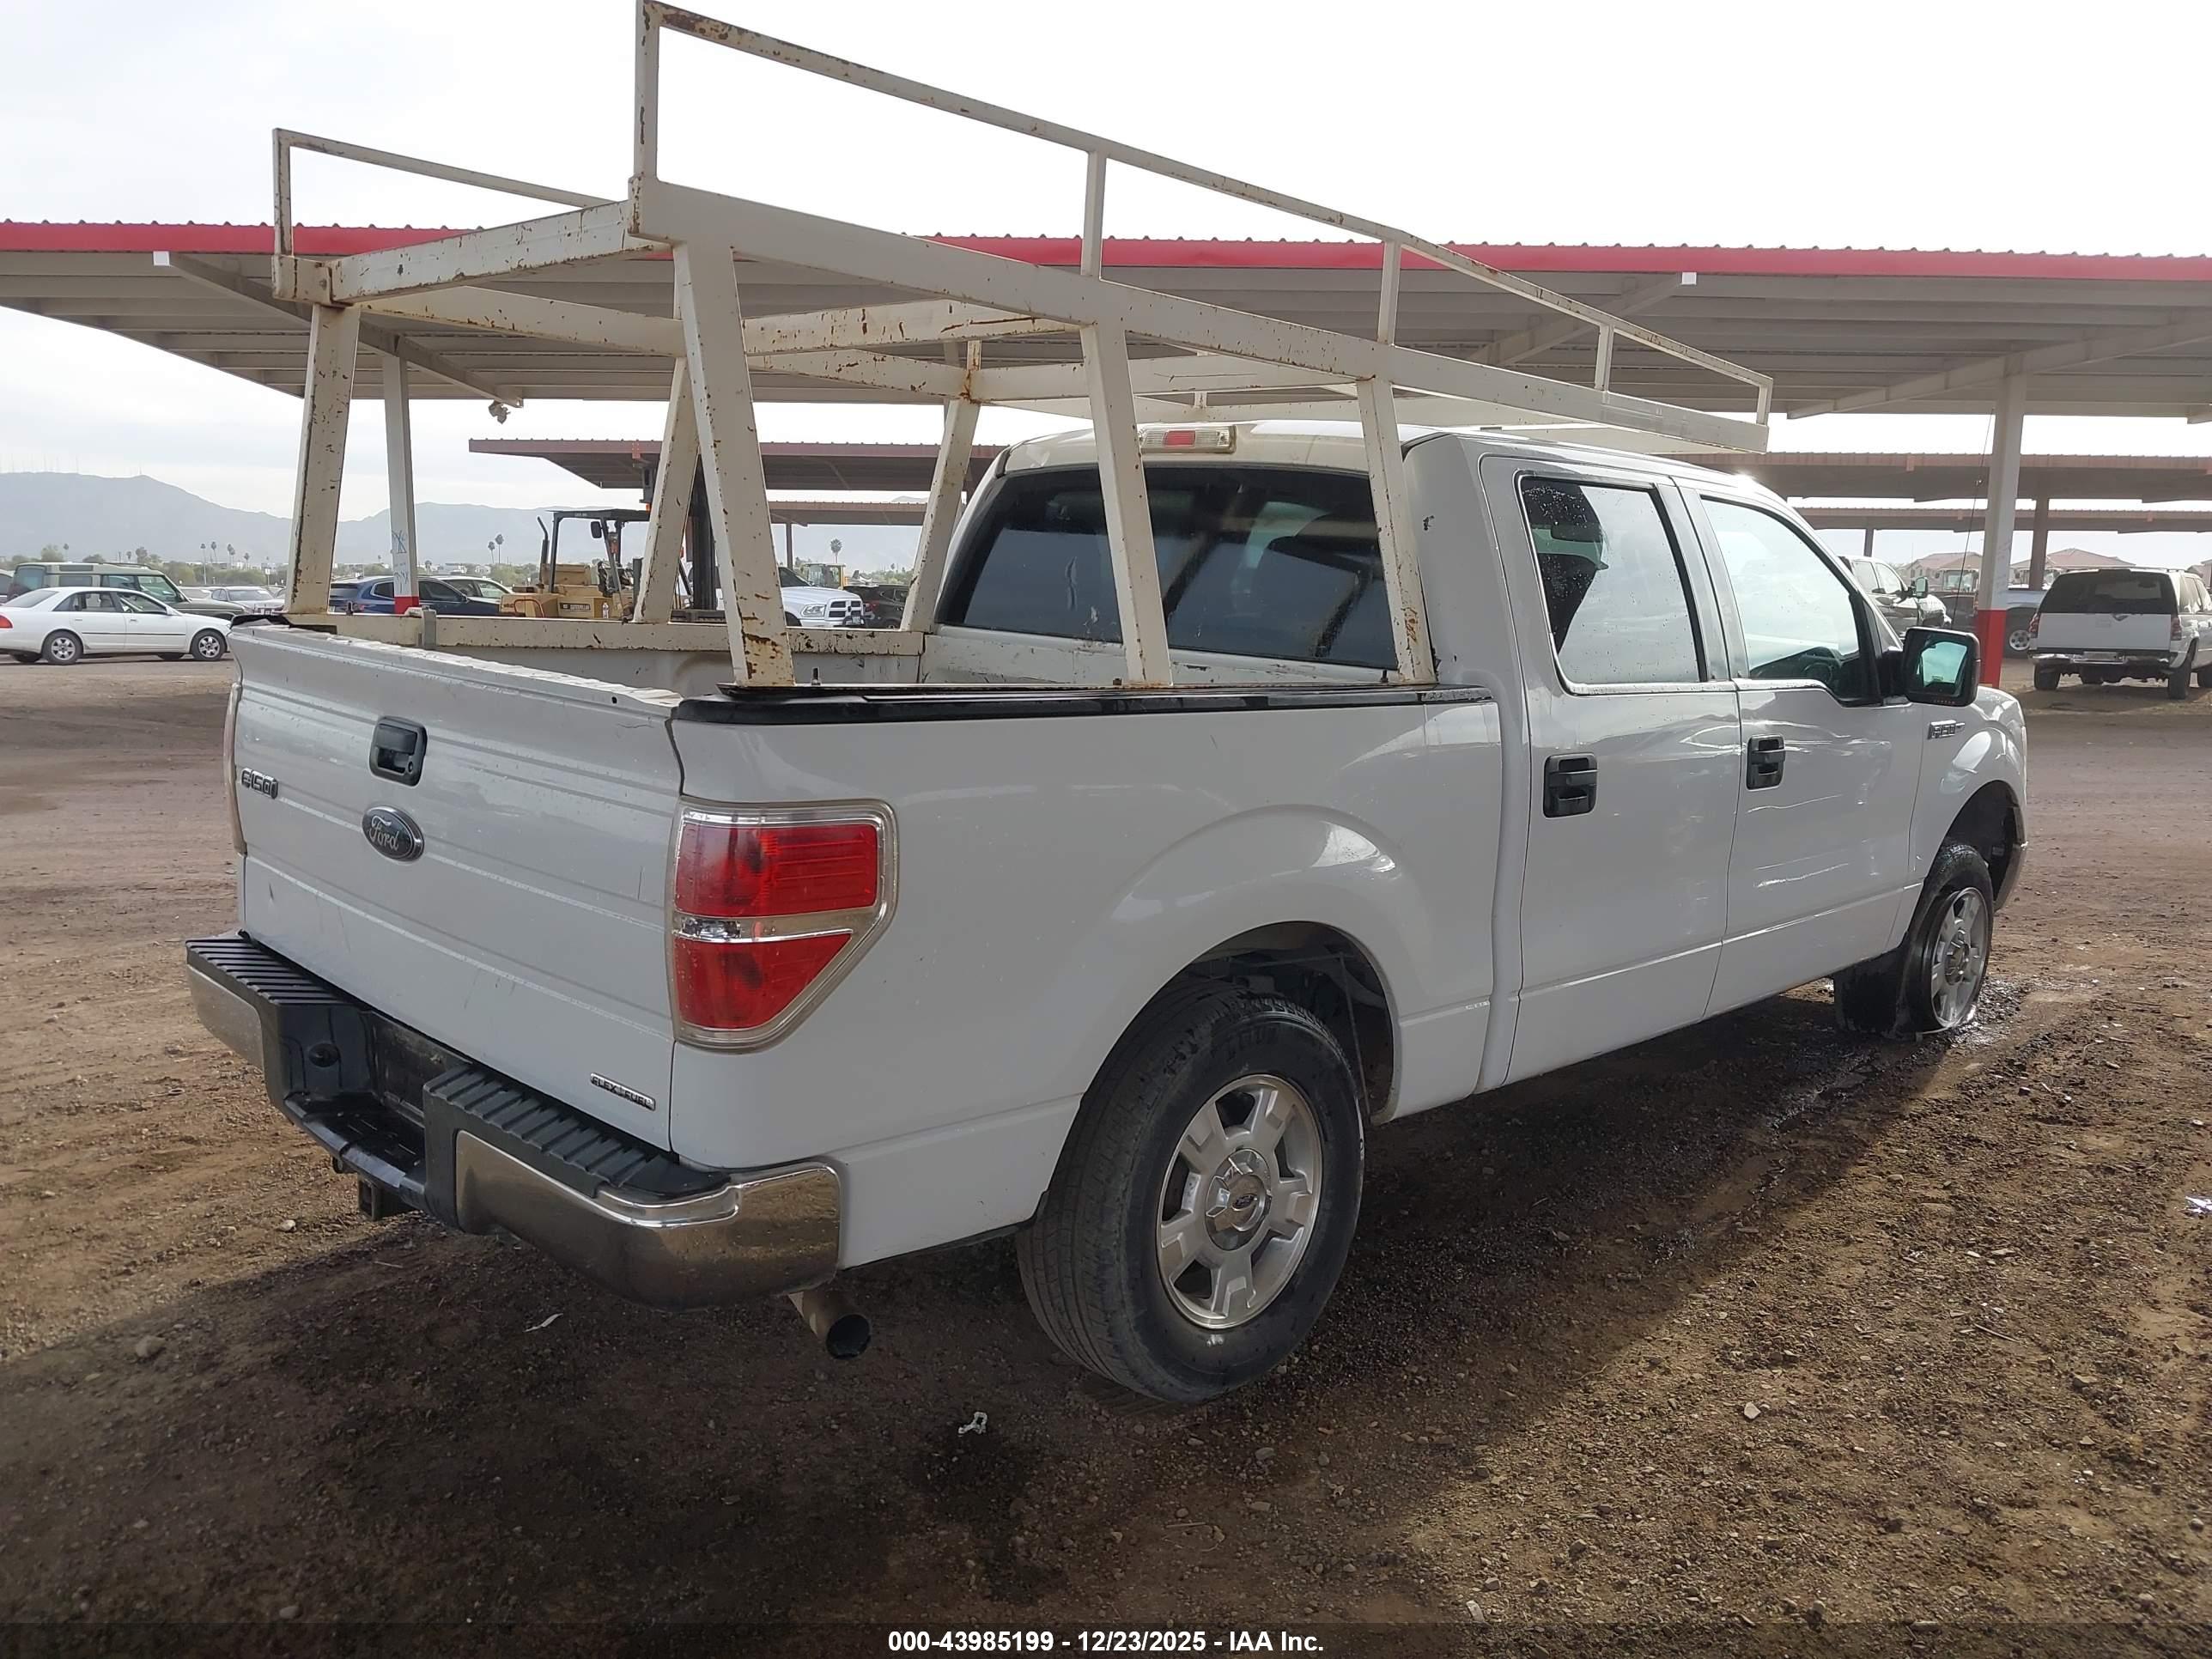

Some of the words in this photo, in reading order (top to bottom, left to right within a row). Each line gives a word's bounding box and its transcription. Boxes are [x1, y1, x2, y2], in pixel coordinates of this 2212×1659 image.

[368, 815, 399, 851] Ford
[591, 1075, 617, 1094] FLEX
[624, 1090, 651, 1109] FUEL
